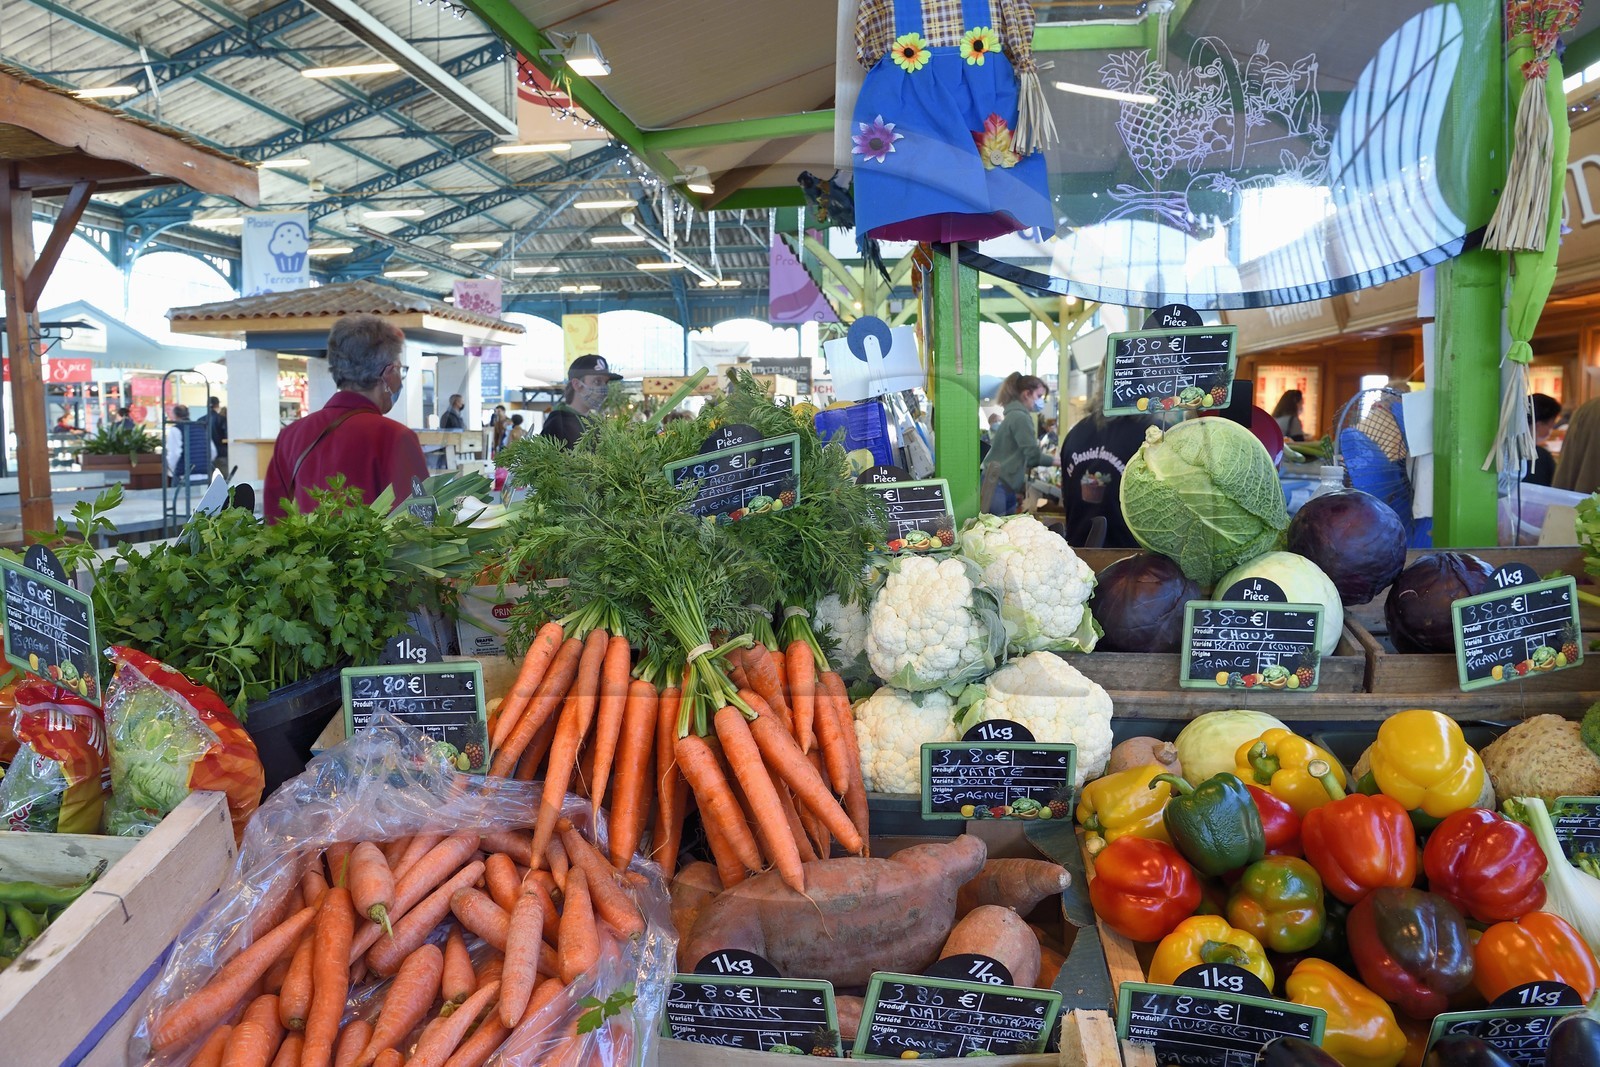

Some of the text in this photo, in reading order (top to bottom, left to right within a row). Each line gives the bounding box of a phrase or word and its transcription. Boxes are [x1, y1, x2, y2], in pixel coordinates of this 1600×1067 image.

[247, 217, 275, 228] Plaisir
[1173, 306, 1181, 316] la
[1163, 315, 1187, 327] Pièce
[1141, 355, 1191, 367] CHOUX
[53, 360, 87, 380] Spice
[1113, 381, 1173, 401] FRANCE
[724, 428, 732, 438] la
[716, 436, 743, 450] Pièce
[880, 466, 888, 475] la
[873, 474, 897, 483] Pièce
[700, 484, 733, 499] FANE
[690, 495, 741, 516] PAGNE
[41, 548, 48, 563] la
[36, 557, 55, 579] Pièce
[1494, 568, 1523, 588] 1kg
[1253, 580, 1262, 591] la
[1243, 589, 1270, 602] Pièce
[23, 600, 68, 629] SALADE
[25, 616, 68, 645] SUCRINE
[1218, 629, 1275, 641] CHOUX
[396, 638, 427, 664] 1kg
[1214, 640, 1252, 651] BLANC
[1192, 657, 1251, 669] FRANCE
[1466, 646, 1514, 670] FRANCE
[353, 700, 374, 708] Produit
[354, 714, 371, 723] Varié
[978, 723, 1014, 740] 1kg
[958, 766, 1025, 780] PATATE
[932, 791, 1005, 804] ESPAGNE
[711, 953, 754, 975] 1kg
[968, 960, 1004, 985] 1kg
[1198, 967, 1244, 992] 1kg
[1518, 985, 1562, 1006] 1kg
[667, 1002, 693, 1010] Produit
[878, 1002, 906, 1012] Produit
[669, 1014, 695, 1023] Variété
[875, 1015, 902, 1024] Variété
[672, 1025, 696, 1033] Origine
[872, 1025, 898, 1034] Origine
[1130, 1027, 1158, 1037] Variété
[1131, 1013, 1277, 1041] Produit AUBERGIN
[672, 1030, 745, 1047] FRANCE
[872, 1033, 953, 1052] FRANCE
[1157, 1052, 1225, 1066] PAGNE
